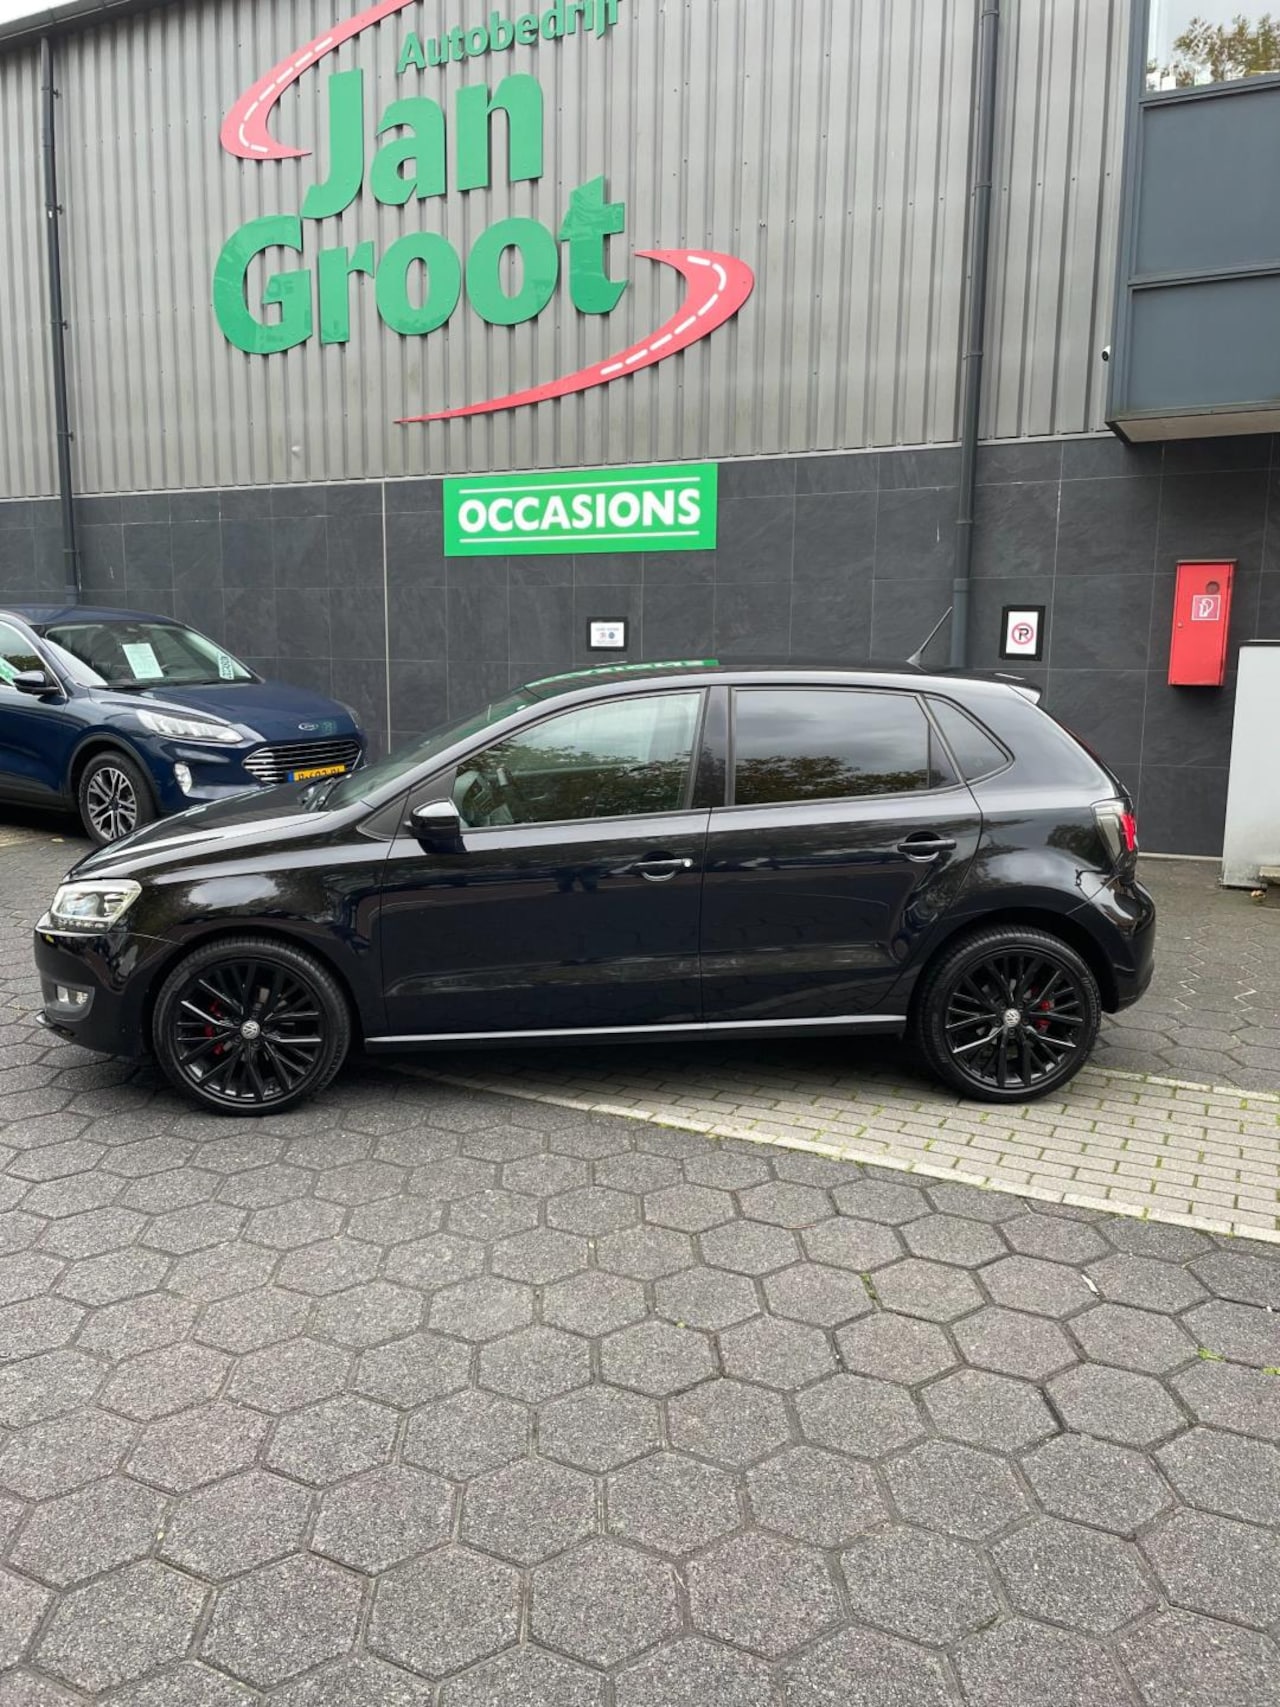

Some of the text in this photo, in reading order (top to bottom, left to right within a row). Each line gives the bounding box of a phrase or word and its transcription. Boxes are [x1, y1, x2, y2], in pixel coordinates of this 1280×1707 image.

[301, 69, 544, 220] Jan
[213, 175, 628, 354] Groot
[458, 488, 700, 533] OCCASIONS
